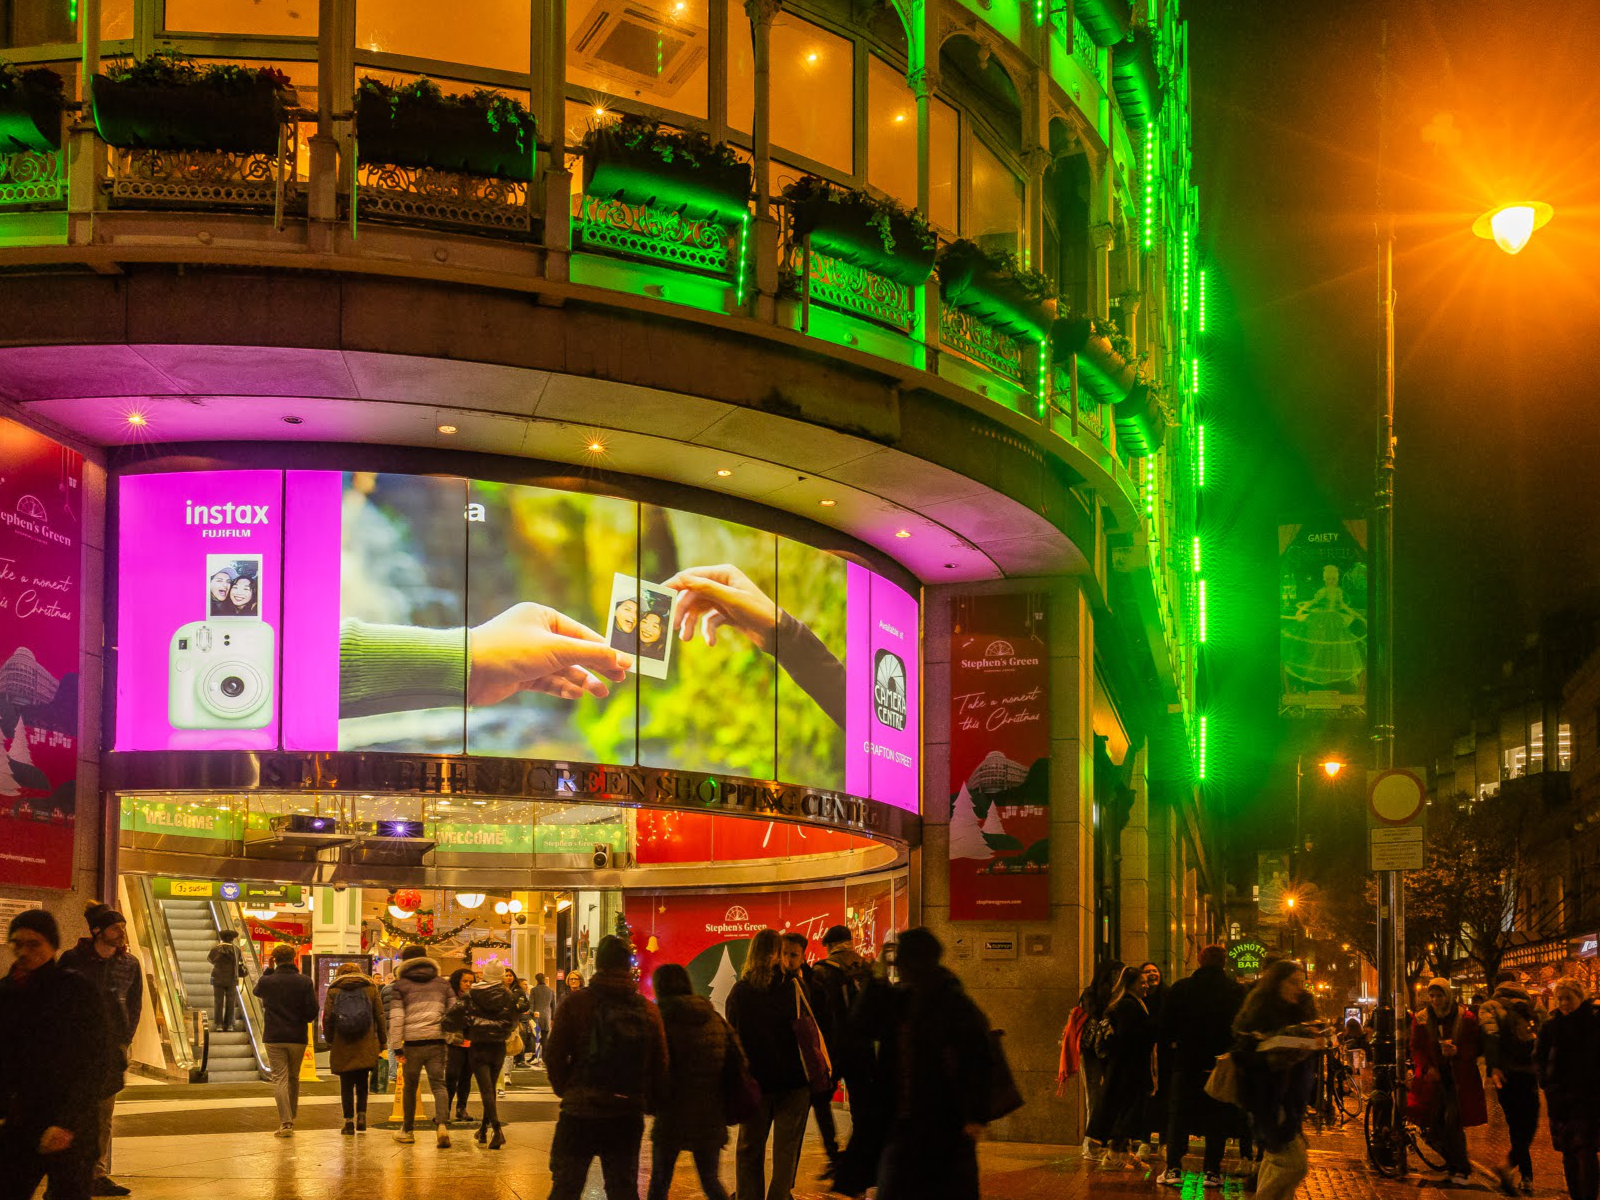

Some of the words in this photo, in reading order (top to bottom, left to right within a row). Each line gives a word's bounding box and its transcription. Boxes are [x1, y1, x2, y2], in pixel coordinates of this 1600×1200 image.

[185, 500, 269, 525] instax
[463, 503, 486, 522] a
[0, 510, 40, 534] ephen's
[41, 524, 71, 547] Green
[202, 529, 251, 538] FUJIFILM
[1308, 533, 1339, 543] GAIETY
[20, 575, 28, 583] a
[32, 576, 73, 592] moment
[15, 589, 71, 619] Christmas
[879, 620, 899, 638] Available
[899, 631, 904, 640] at
[961, 658, 1007, 670] Stephen's
[1009, 657, 1039, 667] Green
[874, 684, 906, 716] CAMERA
[953, 692, 986, 715] Take
[1001, 686, 1042, 704] moment
[877, 706, 904, 731] CENTRE
[958, 716, 980, 731] this
[985, 707, 1040, 732] Christmas
[863, 741, 895, 761] GRAFTON
[895, 751, 913, 768] STREET
[526, 765, 646, 797] GREEN
[655, 775, 797, 815] SHOPPING
[801, 792, 879, 826] CENTRE
[144, 811, 214, 830] WELCOME
[436, 831, 504, 845] WELCOME
[543, 839, 578, 848] Stephen's
[705, 923, 743, 934] Stephen's
[744, 922, 767, 931] Green
